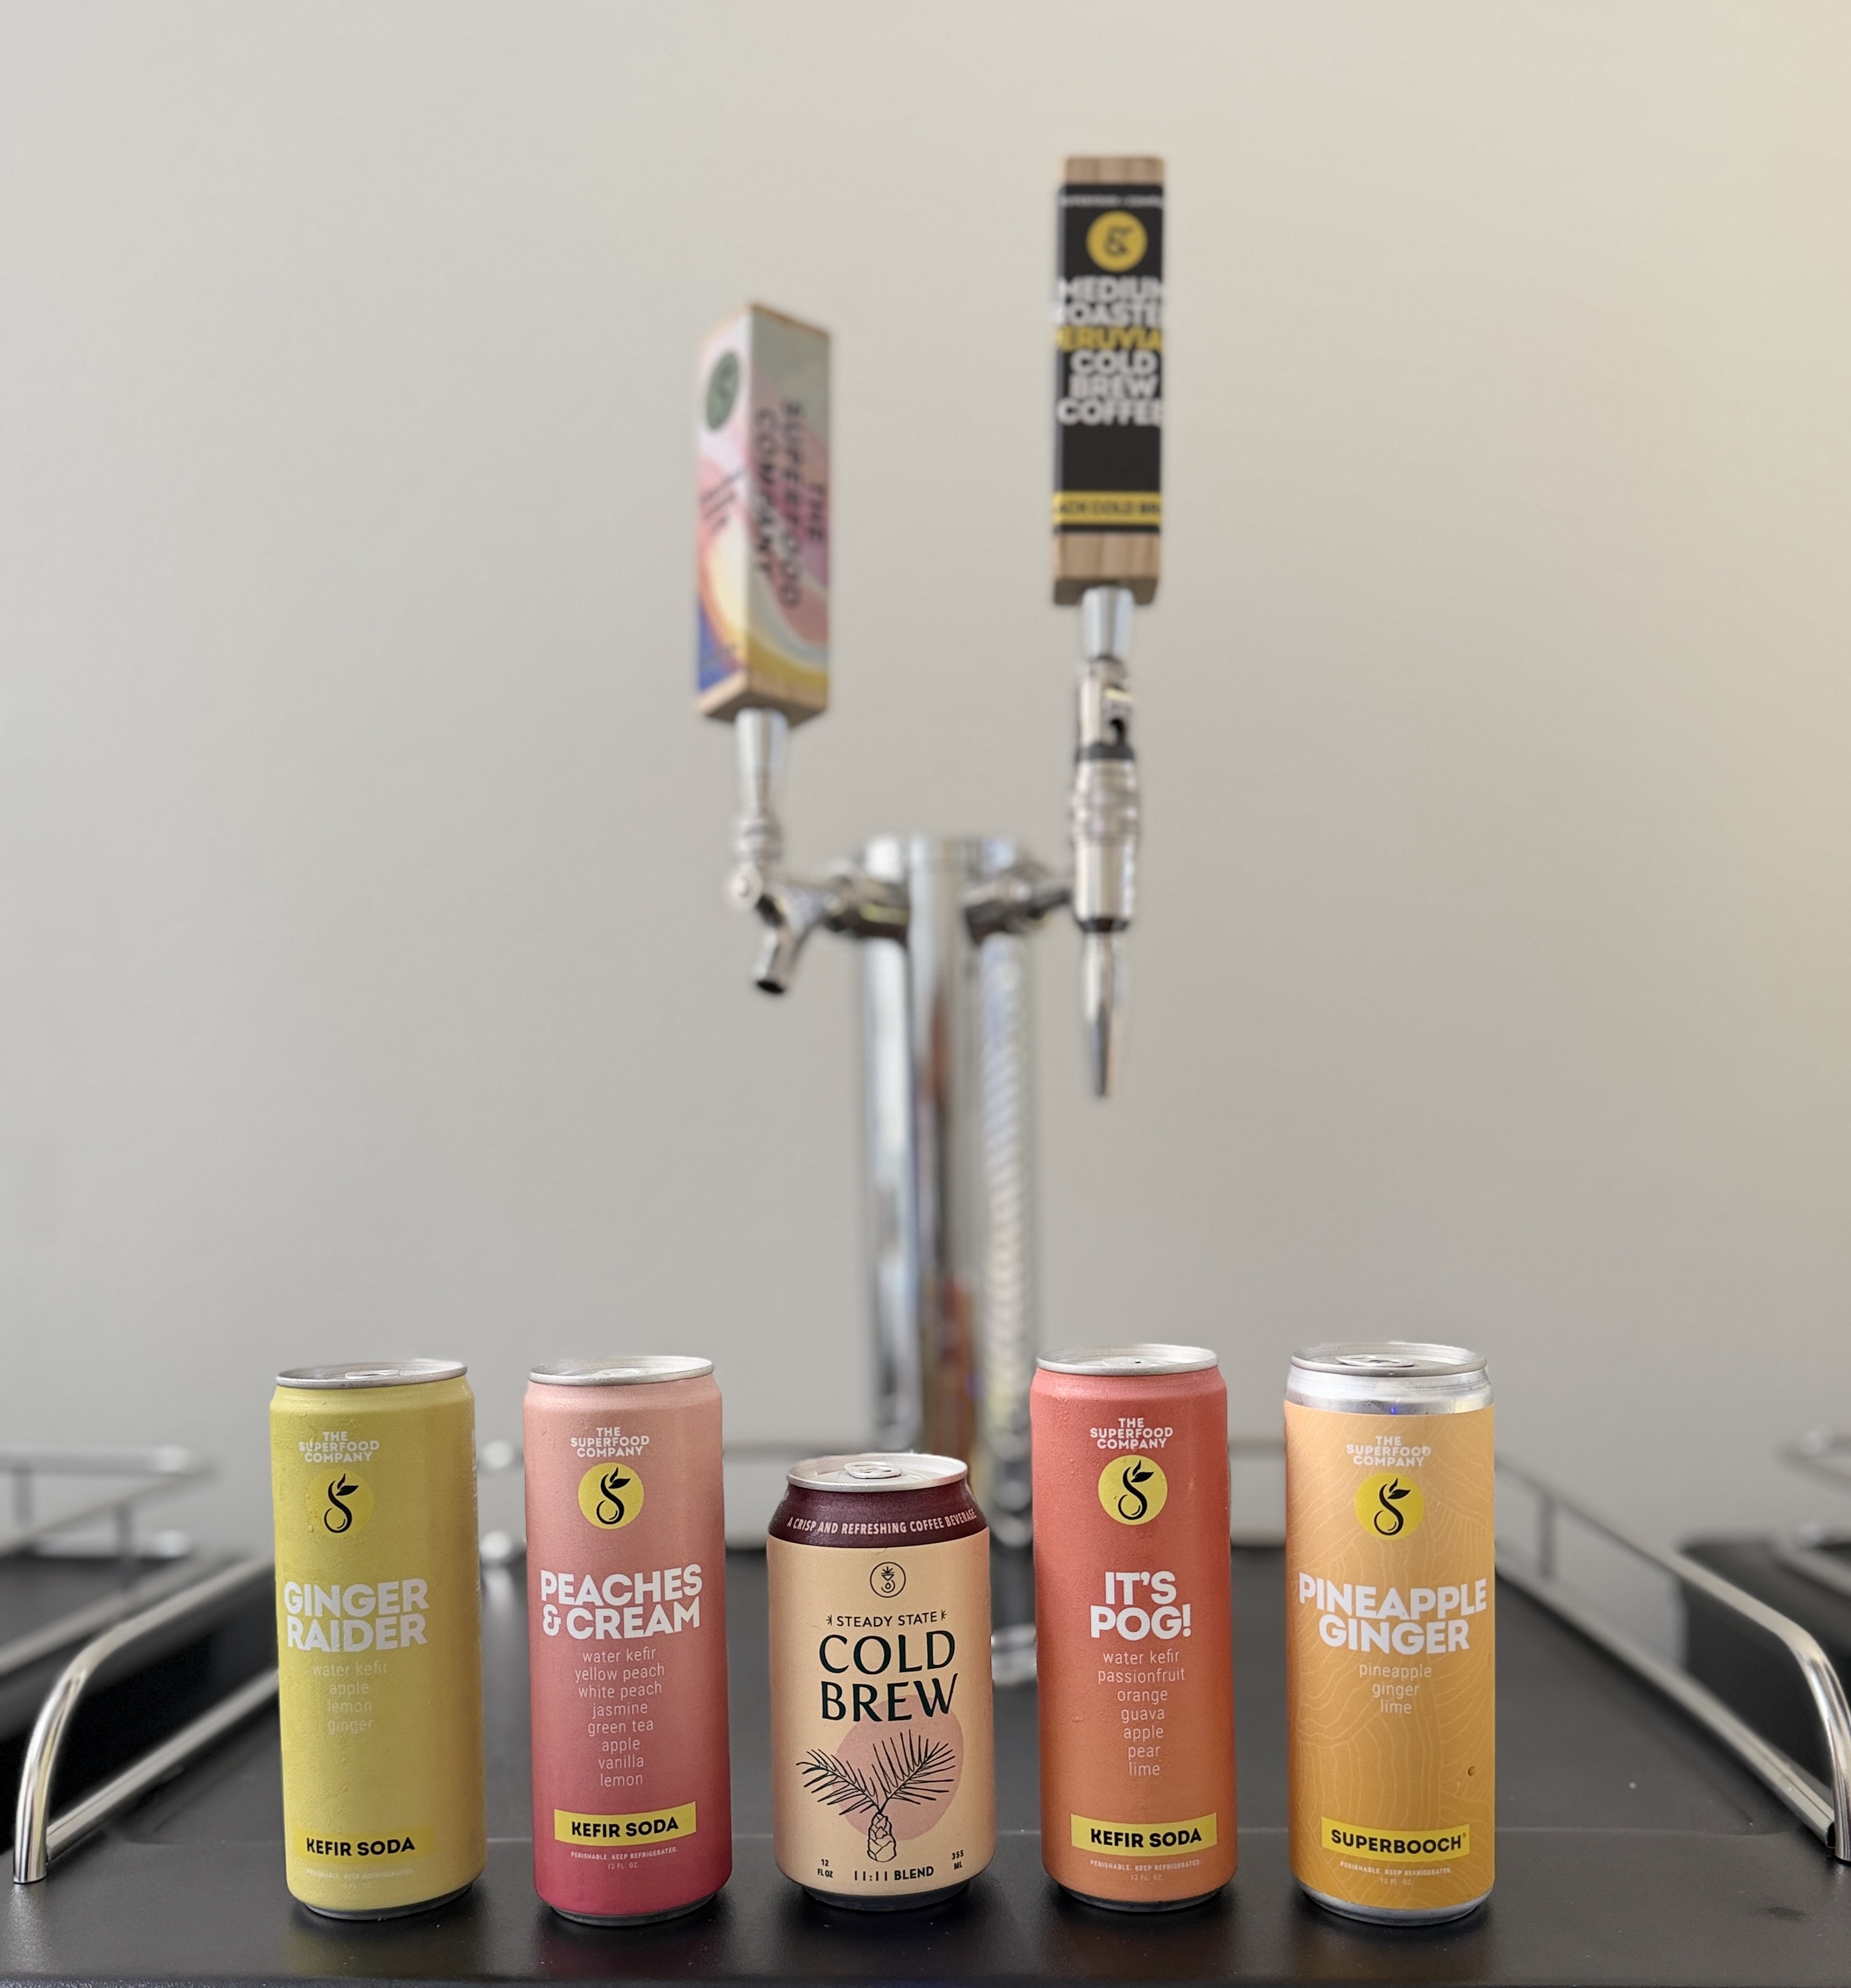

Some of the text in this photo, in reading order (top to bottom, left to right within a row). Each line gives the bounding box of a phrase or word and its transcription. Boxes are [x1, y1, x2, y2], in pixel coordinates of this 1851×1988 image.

[1070, 349, 1158, 376] COLD
[1069, 374, 1158, 399] BREW
[1118, 1417, 1144, 1428] THE
[322, 1431, 348, 1441] THE
[597, 1426, 621, 1437] THE
[1090, 1427, 1174, 1439] SUPERFOOD
[1375, 1435, 1402, 1445] THE
[299, 1439, 380, 1453] SUPERFOOD
[570, 1435, 650, 1448] SUPERFOOD
[1096, 1438, 1167, 1450] COMPANY
[304, 1450, 372, 1463] COMPANY
[576, 1445, 644, 1458] COMPANY
[1346, 1444, 1432, 1457] SUPERFOOD
[1353, 1455, 1425, 1467] COMPANY
[787, 1508, 977, 1534] A CRISP AND REFRESHING COFFEE BEVERAGE
[540, 1564, 703, 1607] PEACHES
[1105, 1571, 1177, 1605] IT'S
[284, 1578, 429, 1618] GINGER
[1299, 1572, 1487, 1620] PINEAPPLE
[837, 1611, 937, 1628] STEADY STATE
[1090, 1603, 1191, 1641] POG!
[286, 1613, 428, 1653] RAIDER
[1319, 1613, 1470, 1655] GINGER
[582, 1647, 656, 1664] water kefir
[819, 1630, 955, 1675] COLD
[1102, 1648, 1180, 1665] water kefir
[313, 1661, 388, 1677] water kefir
[574, 1663, 665, 1683] yellow peach
[1097, 1667, 1185, 1684] passionfruit
[1359, 1663, 1432, 1681] pineapple
[329, 1680, 370, 1697] apple
[578, 1682, 662, 1700] white peach
[1117, 1688, 1168, 1705] orange
[1372, 1681, 1419, 1698] ginger
[820, 1673, 958, 1722] BREW
[327, 1699, 372, 1714] lemon
[592, 1702, 648, 1719] jasmine
[1380, 1699, 1411, 1714] lime
[1121, 1708, 1165, 1724] guava
[327, 1718, 374, 1735] ginger
[588, 1719, 654, 1737] green tea
[1123, 1725, 1164, 1742] apple
[601, 1737, 641, 1754] apple
[1128, 1745, 1160, 1760] pear
[598, 1755, 644, 1770] vanilla
[1129, 1761, 1160, 1776] lime
[600, 1773, 643, 1788] lemon
[571, 1816, 679, 1838] KEFIR SODA
[1090, 1827, 1202, 1848] KEFIR SODA
[307, 1837, 415, 1857] KEFIR SODA
[951, 1849, 964, 1860] 355
[817, 1868, 825, 1876] FL
[854, 1866, 934, 1881] 11:11 BLEND
[953, 1861, 963, 1870] ML
